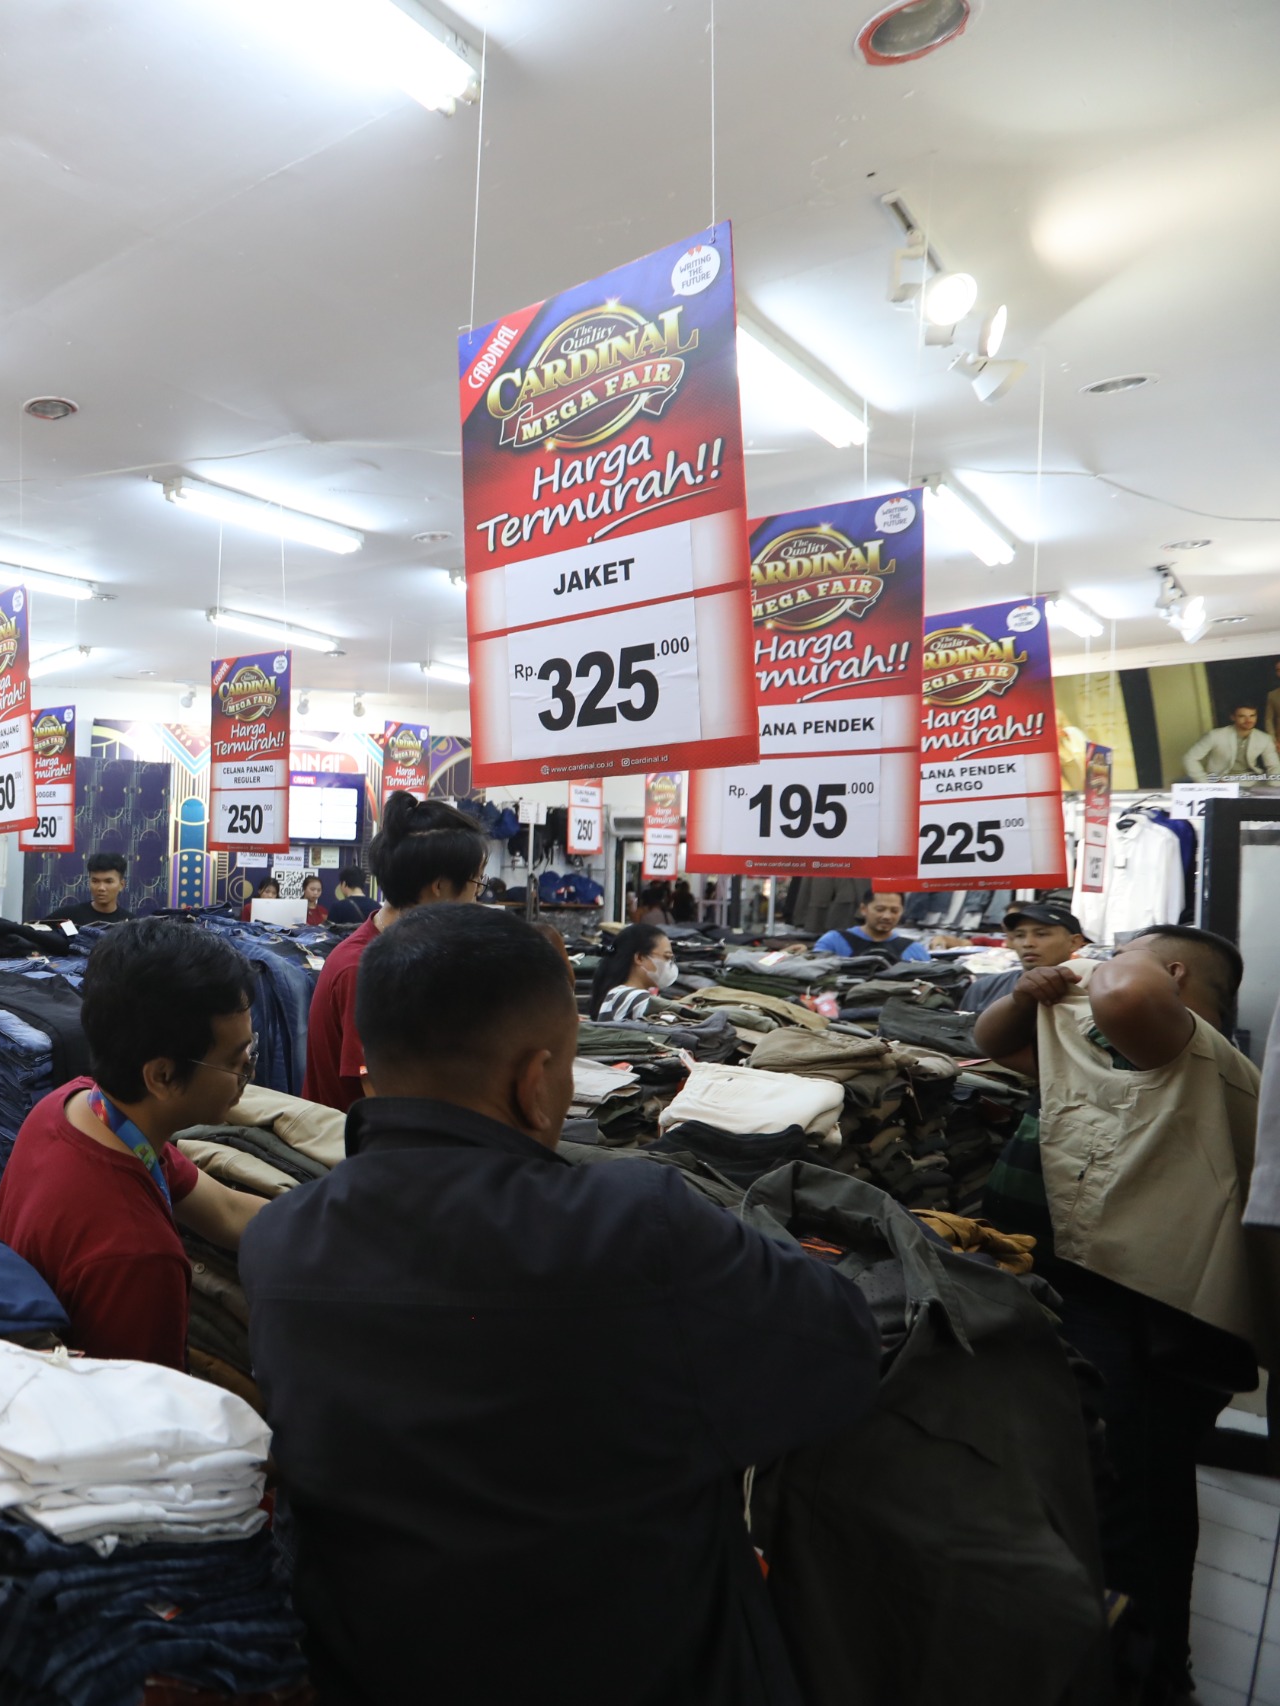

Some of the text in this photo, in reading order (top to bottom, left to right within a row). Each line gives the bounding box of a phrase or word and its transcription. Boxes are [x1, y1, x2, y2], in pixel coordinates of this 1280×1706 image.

[679, 254, 712, 273] WRITING
[688, 266, 703, 277] THE
[681, 272, 711, 289] FUTURE
[560, 325, 616, 353] Quality
[573, 325, 593, 337] The
[468, 324, 519, 389] CARDINAL
[487, 305, 699, 419] CARDINAL
[522, 364, 671, 442] MEGA FAIR
[532, 435, 652, 500] Harga
[476, 437, 722, 551] Termurah!!
[780, 542, 828, 559] Quality
[553, 558, 635, 595] JAKET
[752, 579, 872, 618] MEGA FAIR
[755, 630, 853, 665] Harga
[965, 665, 1009, 681] FAIR
[219, 676, 280, 700] CARDINAL
[514, 664, 537, 681] Rp.
[537, 642, 660, 731] 325
[228, 695, 273, 713] MEGA FAIR
[231, 723, 266, 739] Harga
[759, 717, 875, 736] ANA PENDEK
[214, 731, 285, 756] Termurah!!
[35, 757, 59, 770] Harga
[246, 765, 273, 773] PANJANG
[396, 766, 415, 777] Harga
[551, 754, 669, 774] www.cardinal.co.id cardinal.id
[960, 763, 1016, 777] PENDEK
[234, 776, 260, 784] REGULER
[936, 781, 983, 793] CARGO
[228, 804, 263, 834] 250
[729, 785, 748, 798] Rp.
[749, 783, 847, 839] 195
[33, 816, 57, 838] 250
[577, 820, 592, 841] 250
[920, 820, 1004, 865] 225
[653, 853, 668, 869] 225
